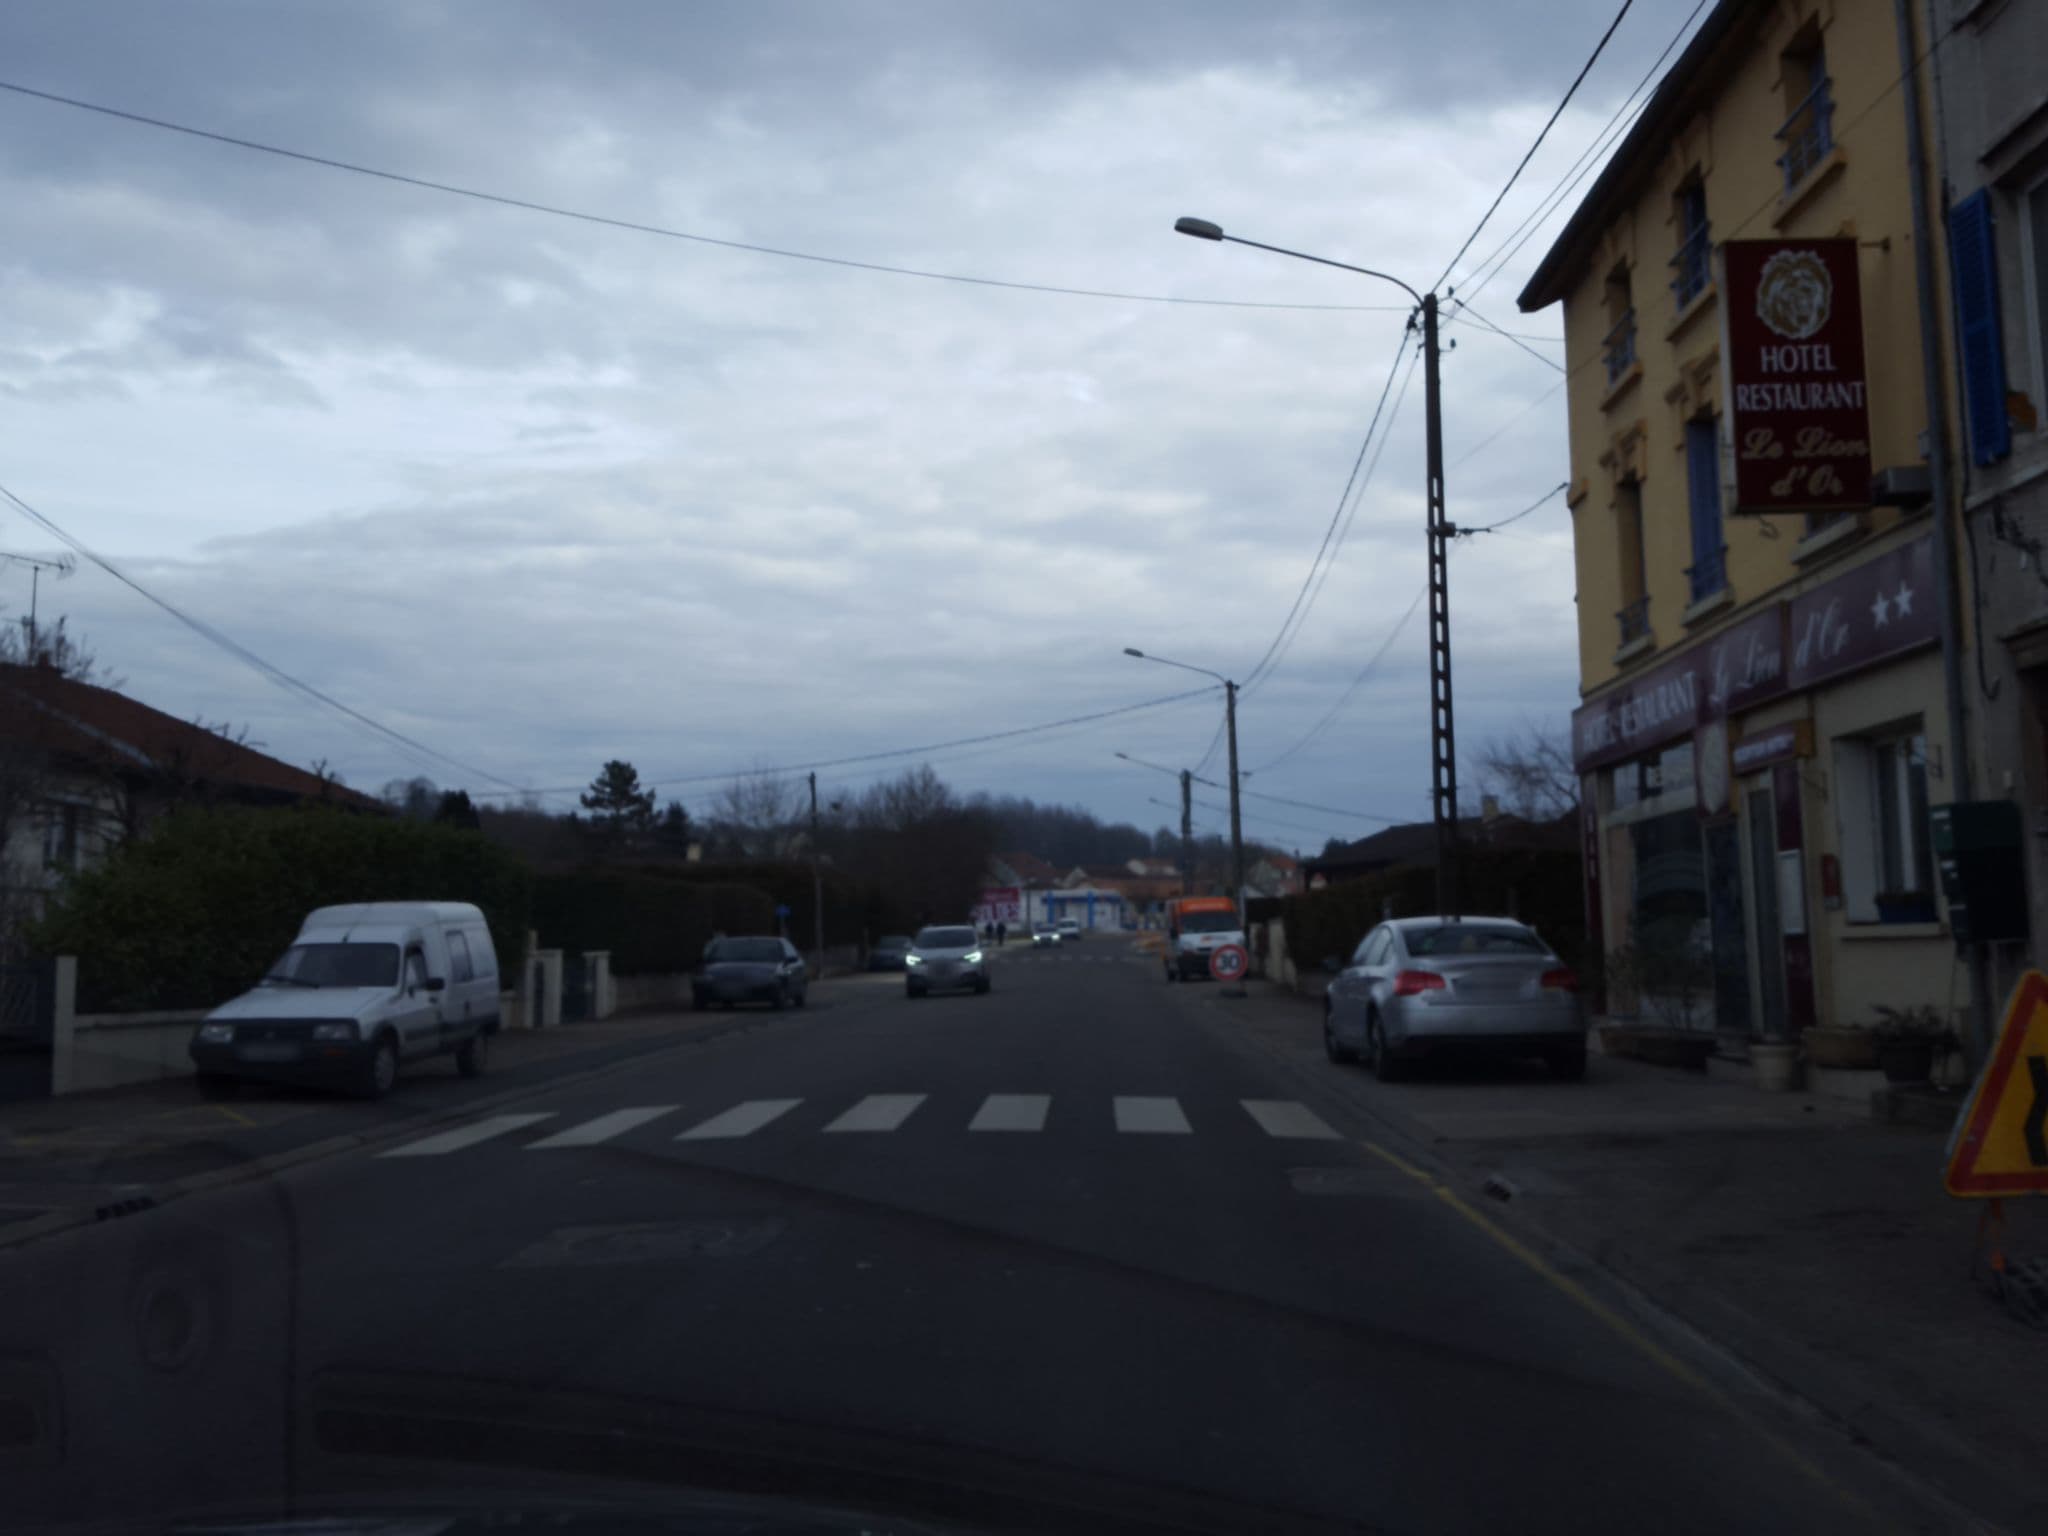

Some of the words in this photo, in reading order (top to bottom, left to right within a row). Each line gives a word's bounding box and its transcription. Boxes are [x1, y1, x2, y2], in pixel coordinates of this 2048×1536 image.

[1760, 343, 1838, 374] HOTEL
[1736, 380, 1865, 412] RESTAURANT
[1741, 426, 1785, 460] Le
[1792, 424, 1869, 459] Lion
[1219, 953, 1240, 971] 30
